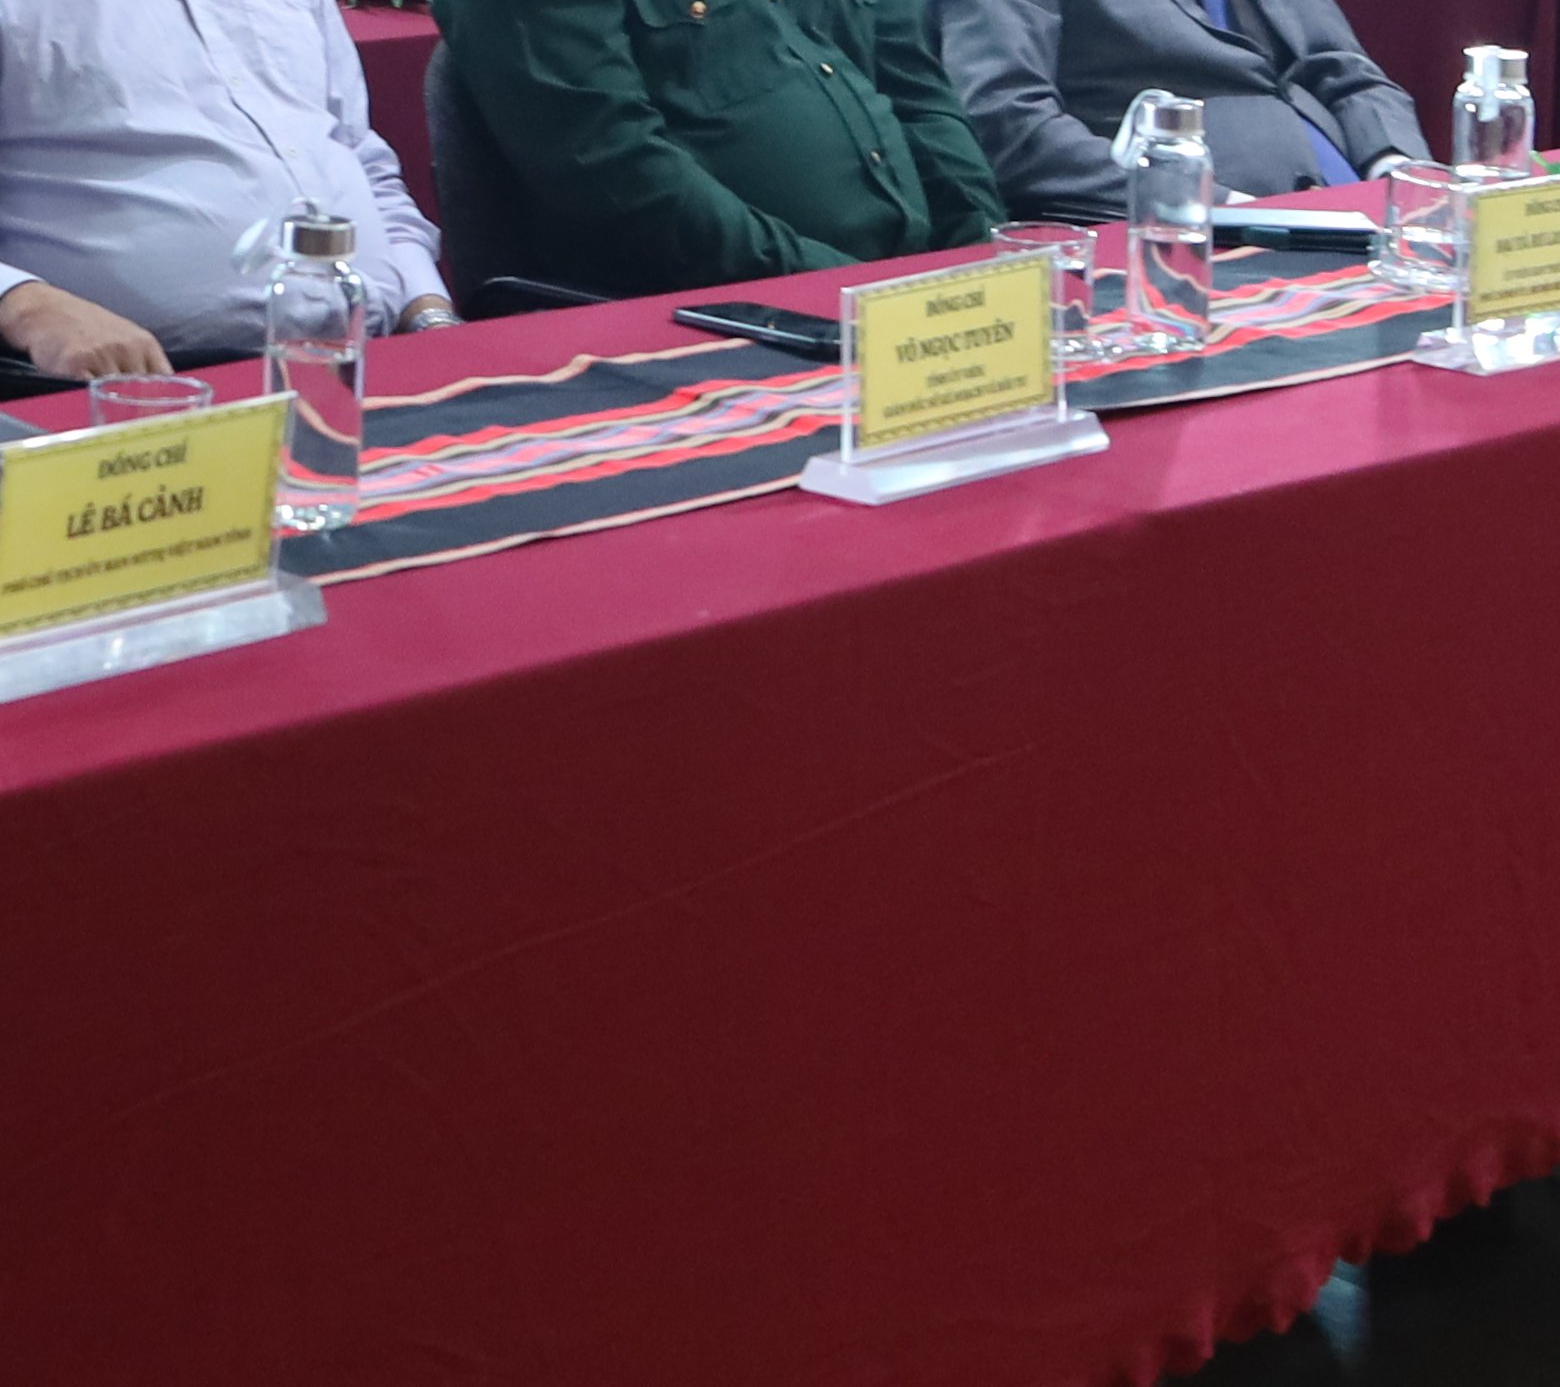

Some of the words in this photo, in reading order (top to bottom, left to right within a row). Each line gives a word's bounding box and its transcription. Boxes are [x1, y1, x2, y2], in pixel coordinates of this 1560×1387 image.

[67, 502, 97, 539] LÊ
[101, 493, 133, 531] BÁ
[137, 484, 205, 523] CẢNH
